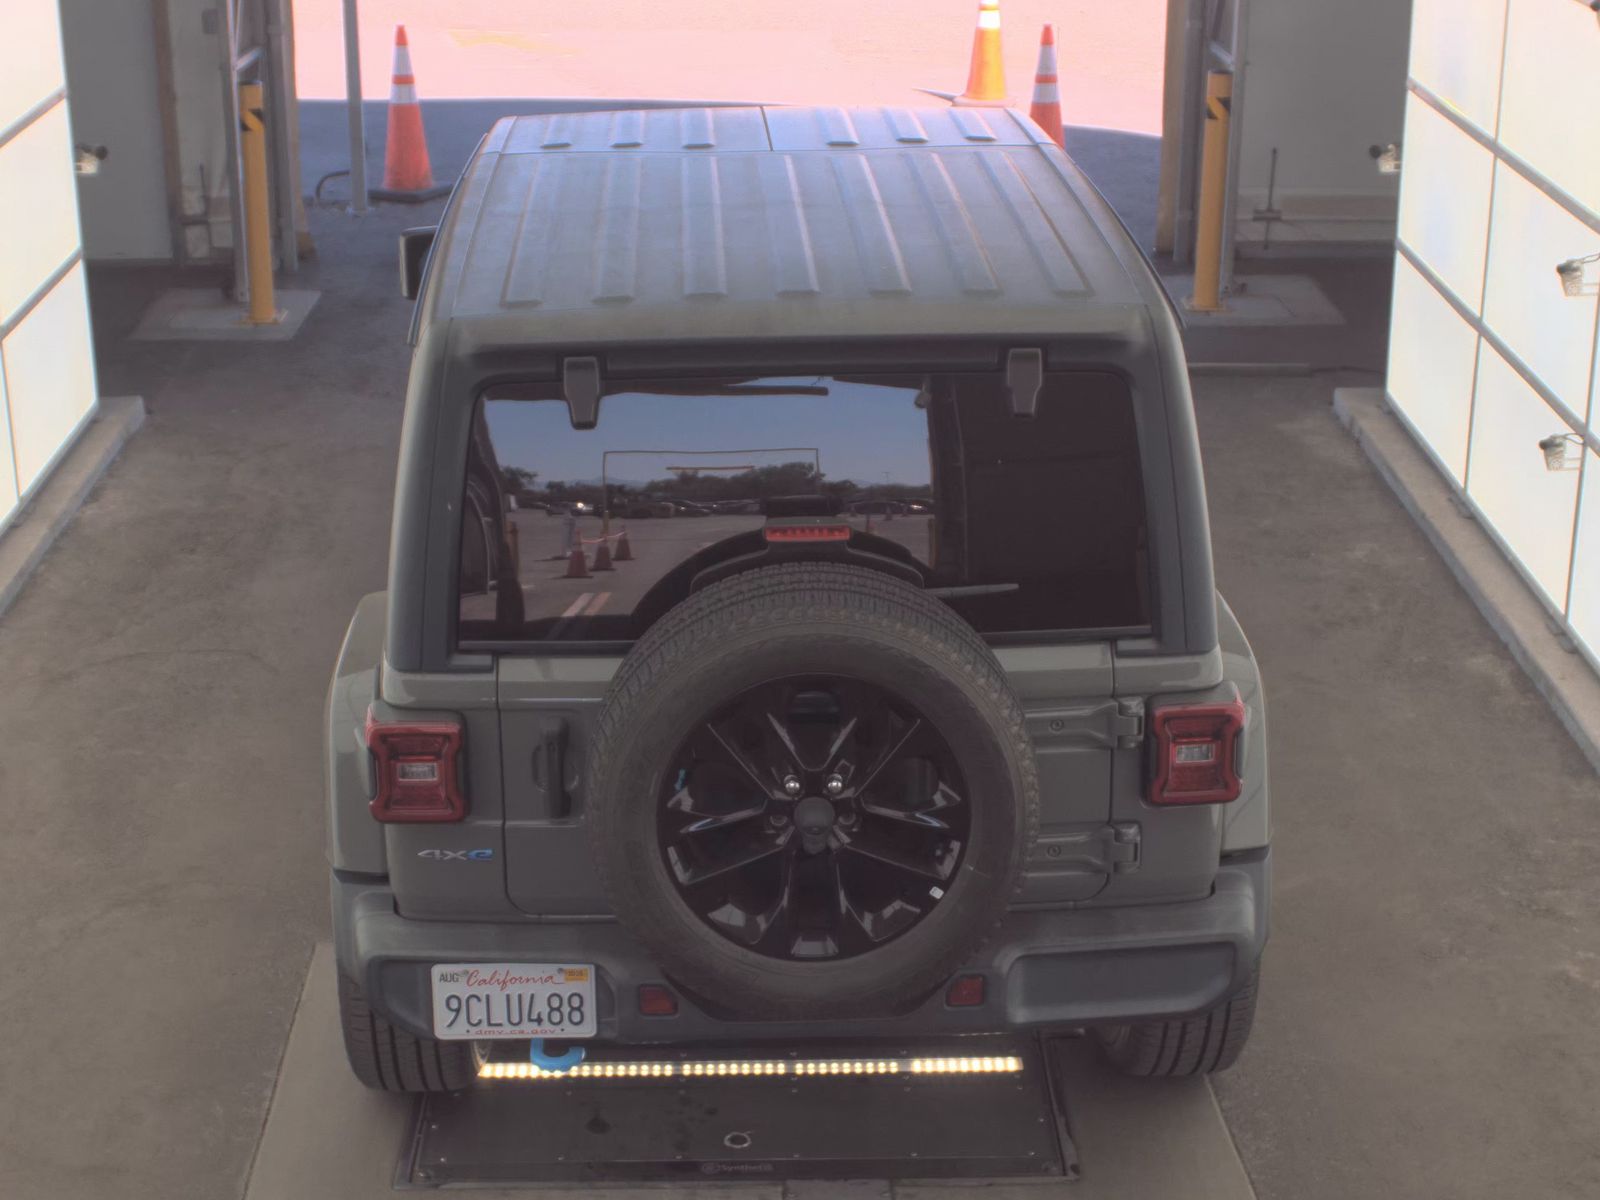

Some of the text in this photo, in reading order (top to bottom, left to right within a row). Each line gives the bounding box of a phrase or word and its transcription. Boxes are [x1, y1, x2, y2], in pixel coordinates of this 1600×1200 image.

[439, 970, 460, 983] AUG
[465, 968, 565, 991] California
[445, 992, 585, 1028] 9CLU488
[474, 1027, 557, 1036] dmv.ca.gov
